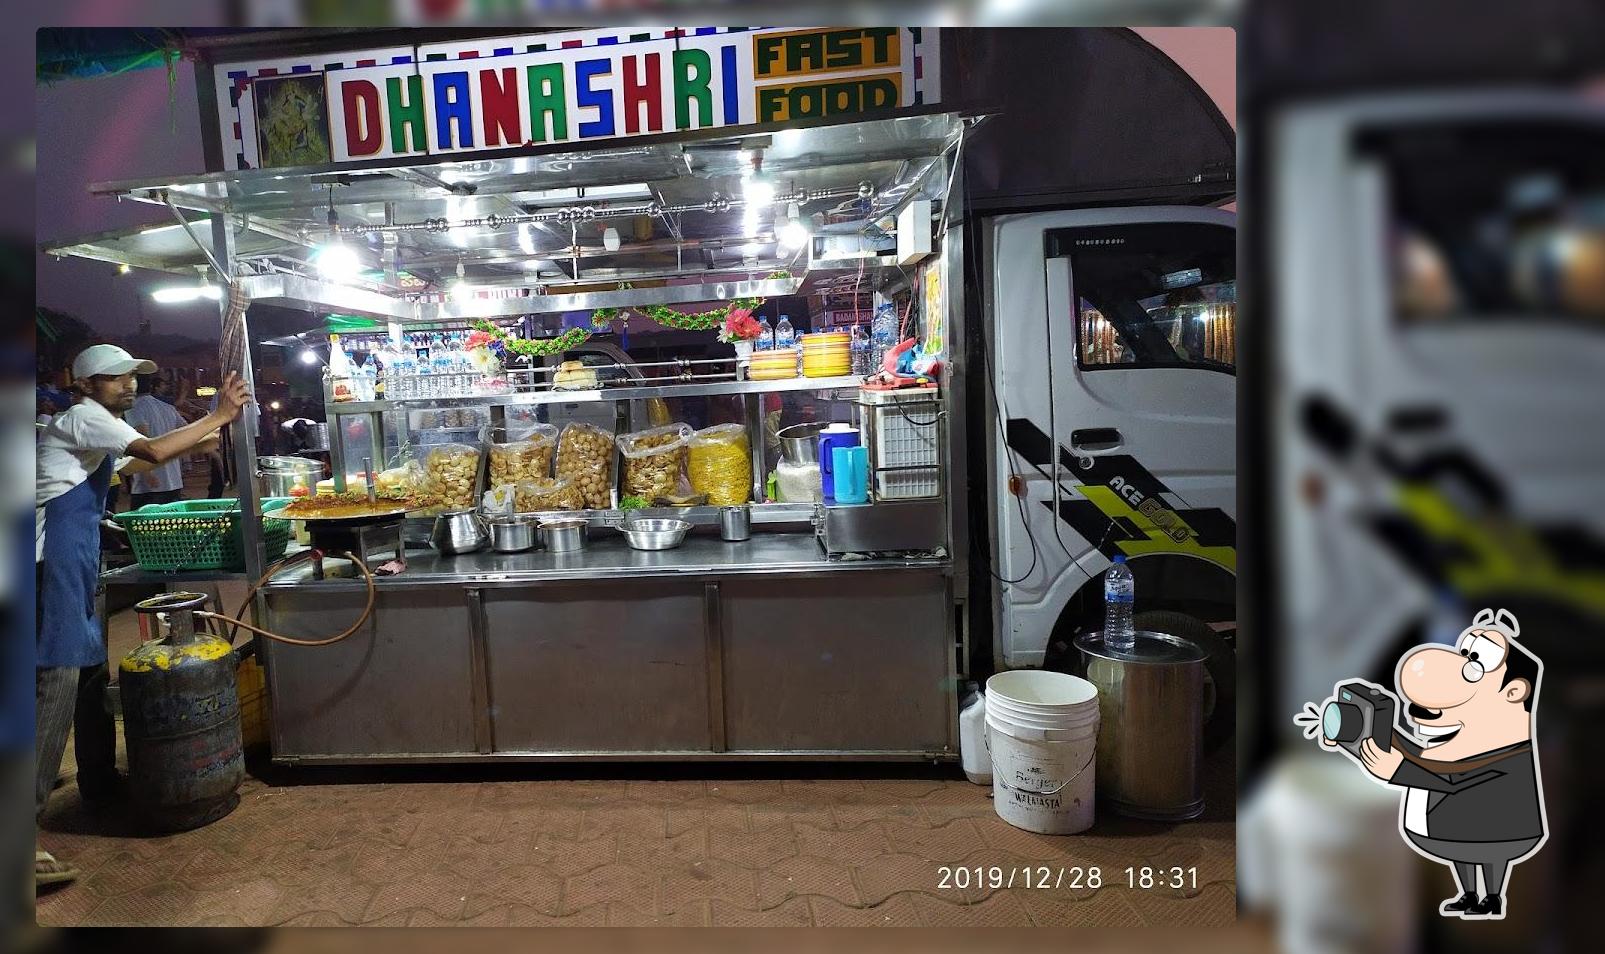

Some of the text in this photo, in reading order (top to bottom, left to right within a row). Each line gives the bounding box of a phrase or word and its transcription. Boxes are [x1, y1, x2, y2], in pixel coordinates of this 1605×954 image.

[758, 27, 897, 75] FAST
[342, 45, 740, 156] DHANASHRI
[760, 78, 898, 122] FOOD
[1109, 475, 1190, 544] ACE GOLD
